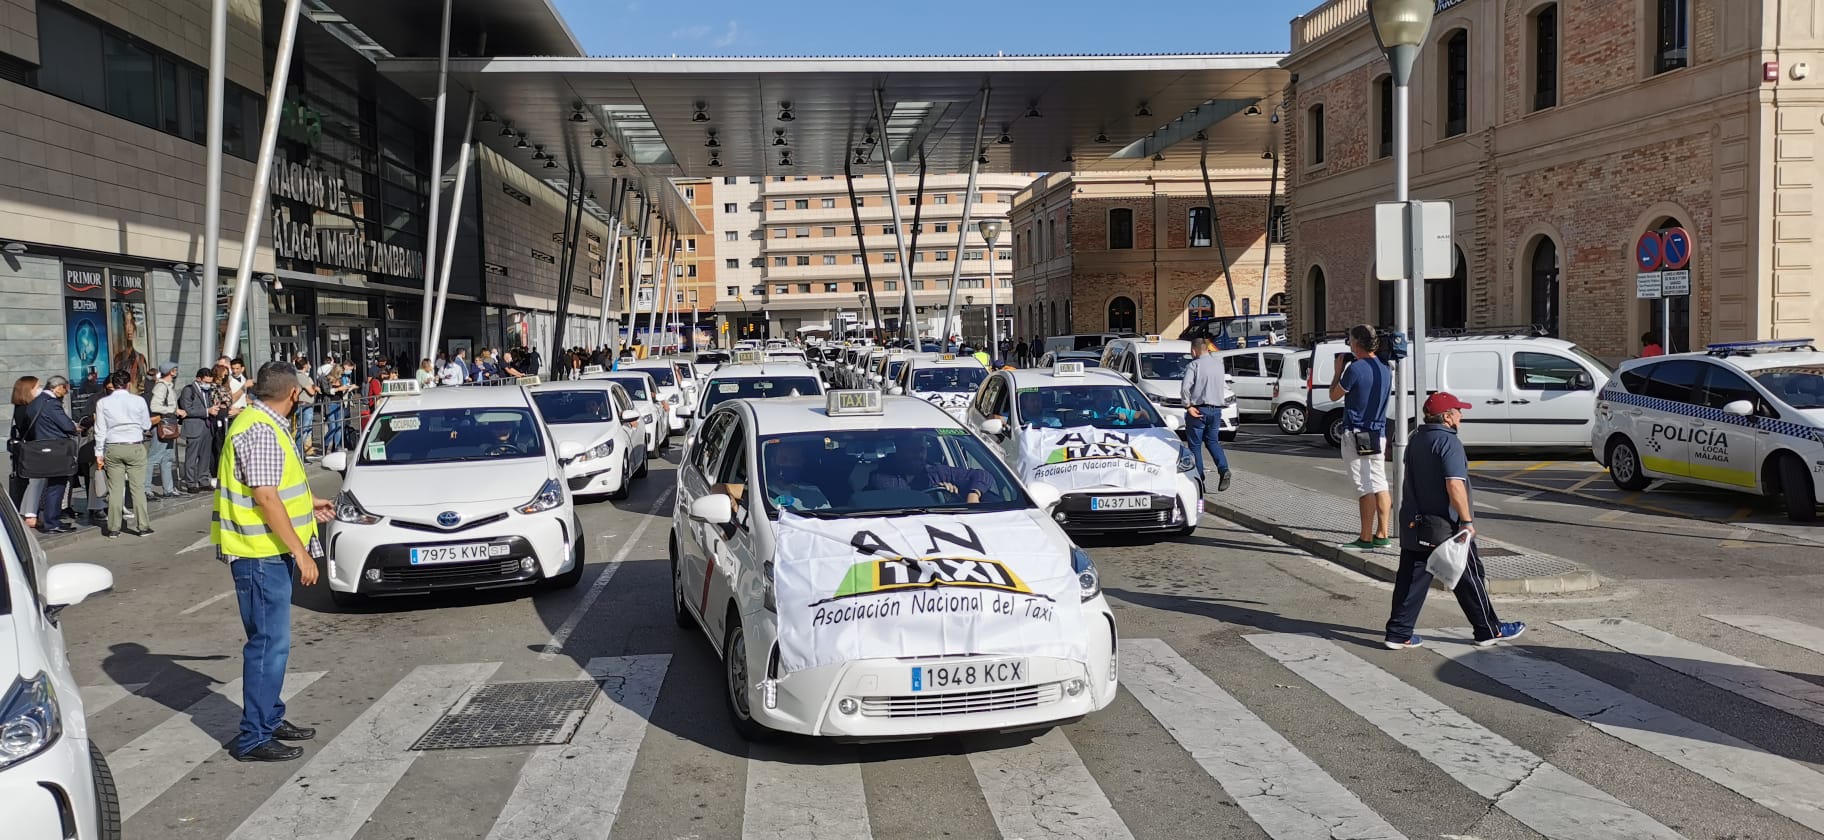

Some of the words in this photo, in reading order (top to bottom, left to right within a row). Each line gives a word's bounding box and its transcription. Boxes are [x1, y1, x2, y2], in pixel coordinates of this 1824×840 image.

[270, 154, 325, 208] TACIÓN
[328, 176, 349, 214] DE
[271, 207, 321, 263] ÁLAGA
[326, 226, 367, 271] MARÍA
[370, 239, 425, 279] ZAMBRANO
[66, 270, 102, 285] PRIMOR
[112, 274, 143, 289] PRIMOR
[389, 381, 408, 392] TAXI
[840, 394, 865, 407] TAXI
[1651, 423, 1729, 448] POLICÍA
[1068, 444, 1137, 459] TAXI
[1702, 445, 1729, 455] LOCAL
[1034, 463, 1078, 479] Asociación
[1081, 460, 1121, 472] Nacional
[1124, 460, 1138, 470] del
[1143, 463, 1160, 477] Taxi
[1098, 498, 1125, 509] 0437
[1128, 496, 1149, 508] LNC
[421, 547, 458, 562] 7975
[461, 545, 488, 559] KVR
[490, 545, 509, 556] SP
[883, 559, 1007, 586] TAXI
[812, 597, 900, 627] Asociación
[911, 591, 984, 615] Nacional
[992, 594, 1015, 616] del
[1024, 599, 1054, 623] Taxi
[926, 665, 977, 688] 1948
[984, 661, 1022, 682] KCX
